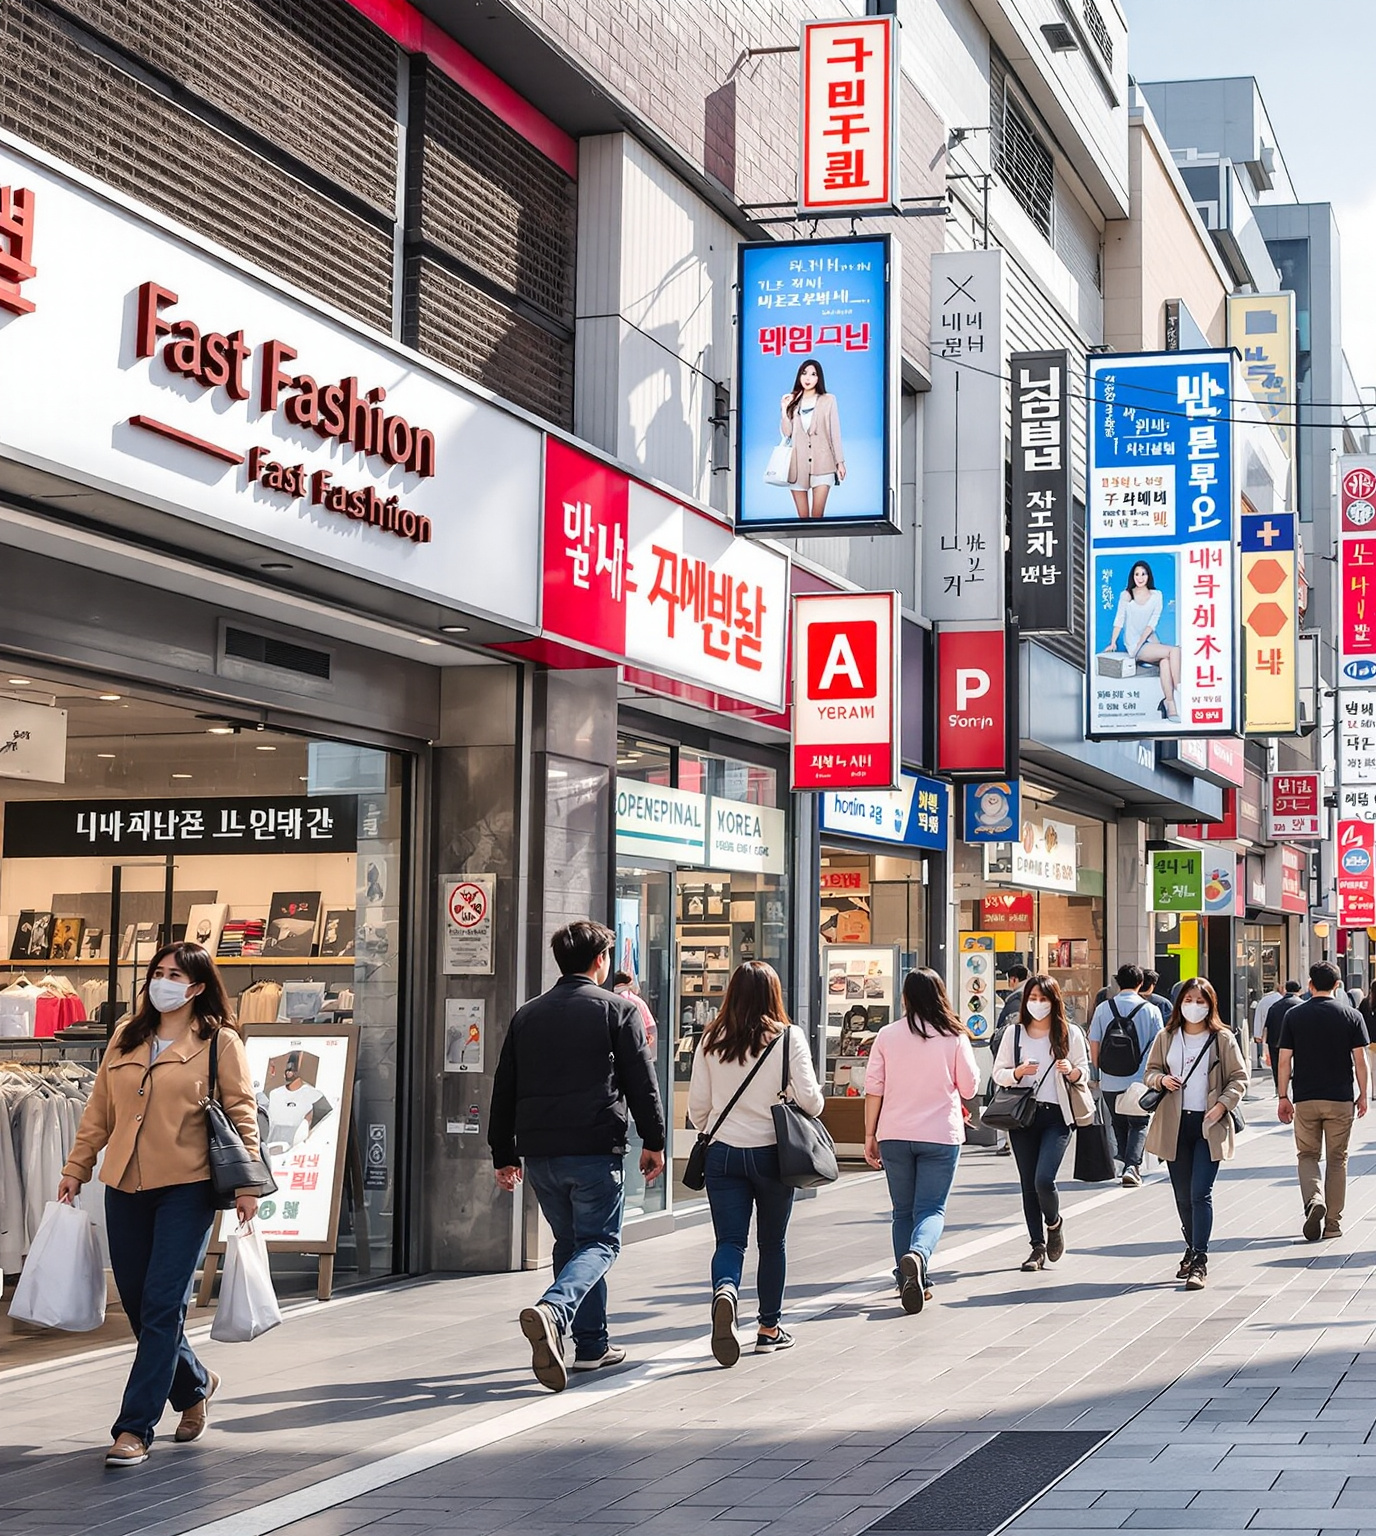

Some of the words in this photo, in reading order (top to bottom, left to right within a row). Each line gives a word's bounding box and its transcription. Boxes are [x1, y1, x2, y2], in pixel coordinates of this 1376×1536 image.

[136, 281, 251, 402] Fast
[260, 339, 436, 478] Fashion
[248, 445, 308, 499] Fast
[818, 634, 864, 689] A
[957, 669, 991, 711] P
